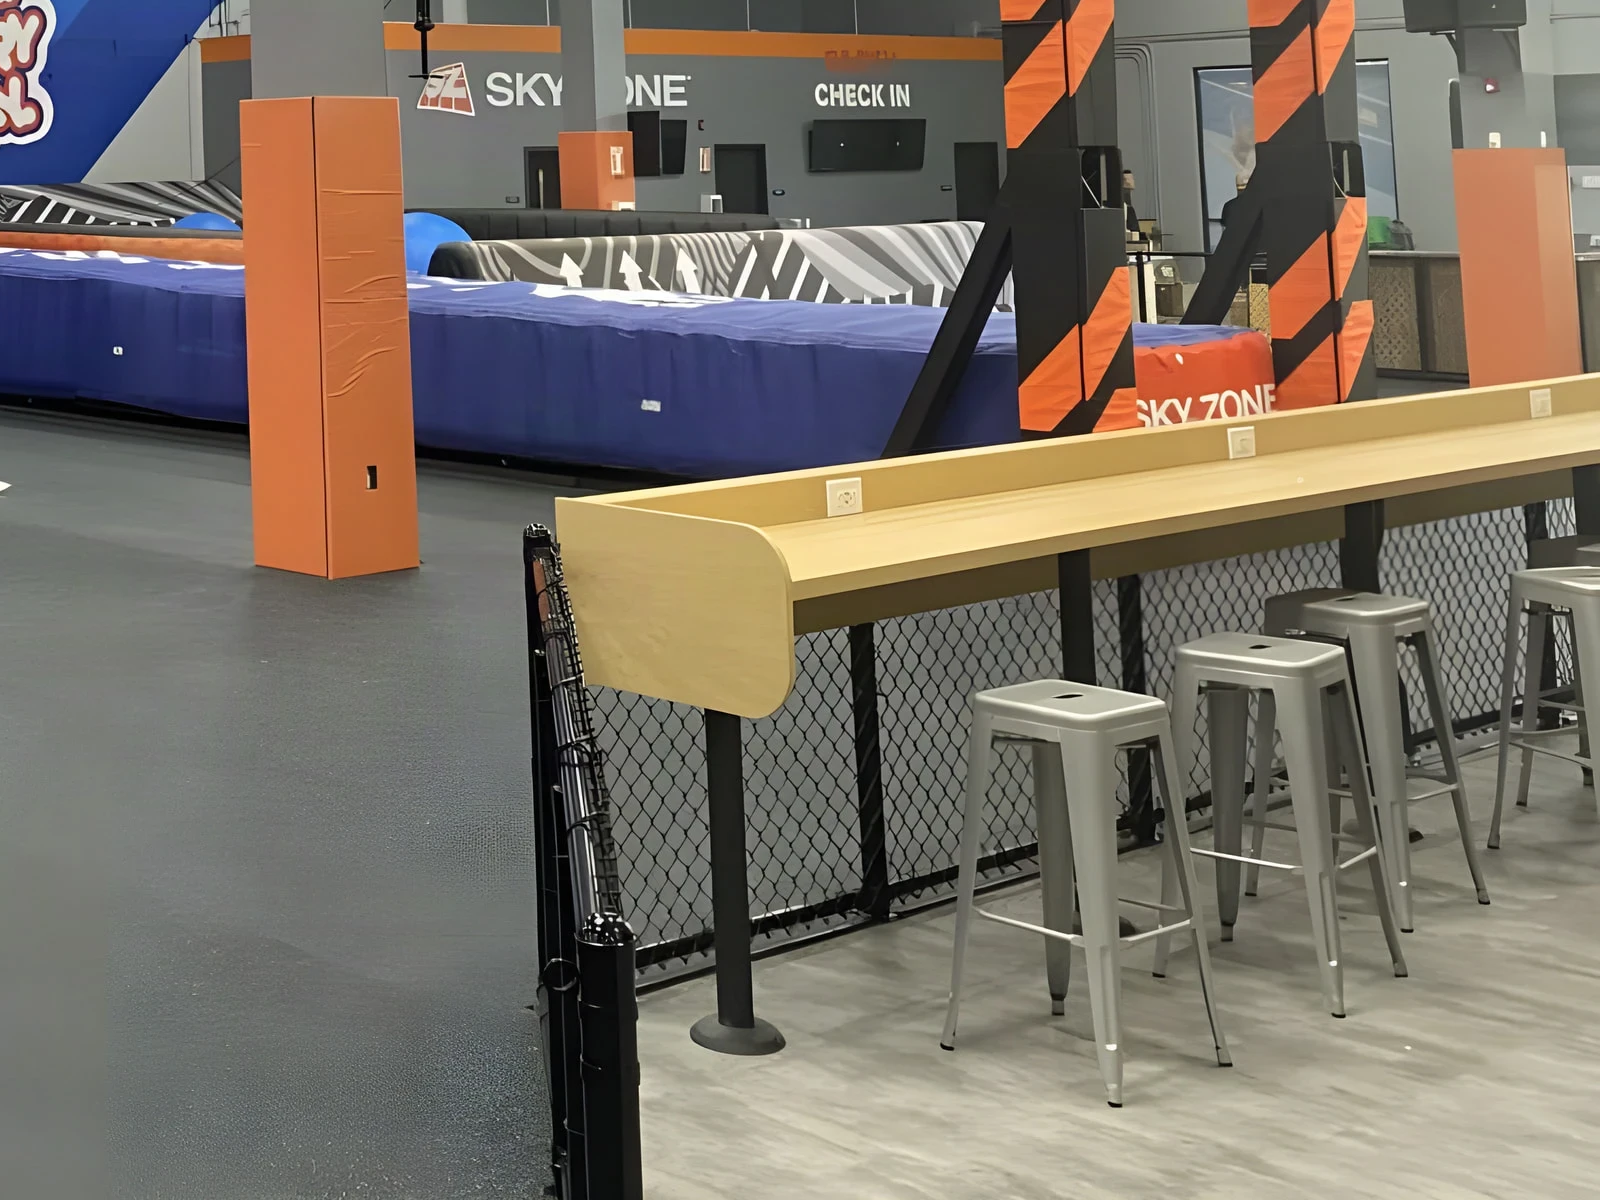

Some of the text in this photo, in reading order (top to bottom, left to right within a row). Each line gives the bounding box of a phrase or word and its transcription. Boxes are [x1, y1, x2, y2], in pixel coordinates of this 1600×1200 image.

[486, 72, 562, 107] SKY
[815, 83, 910, 107] CHECK IN
[1136, 384, 1276, 427] SKY ZONE
